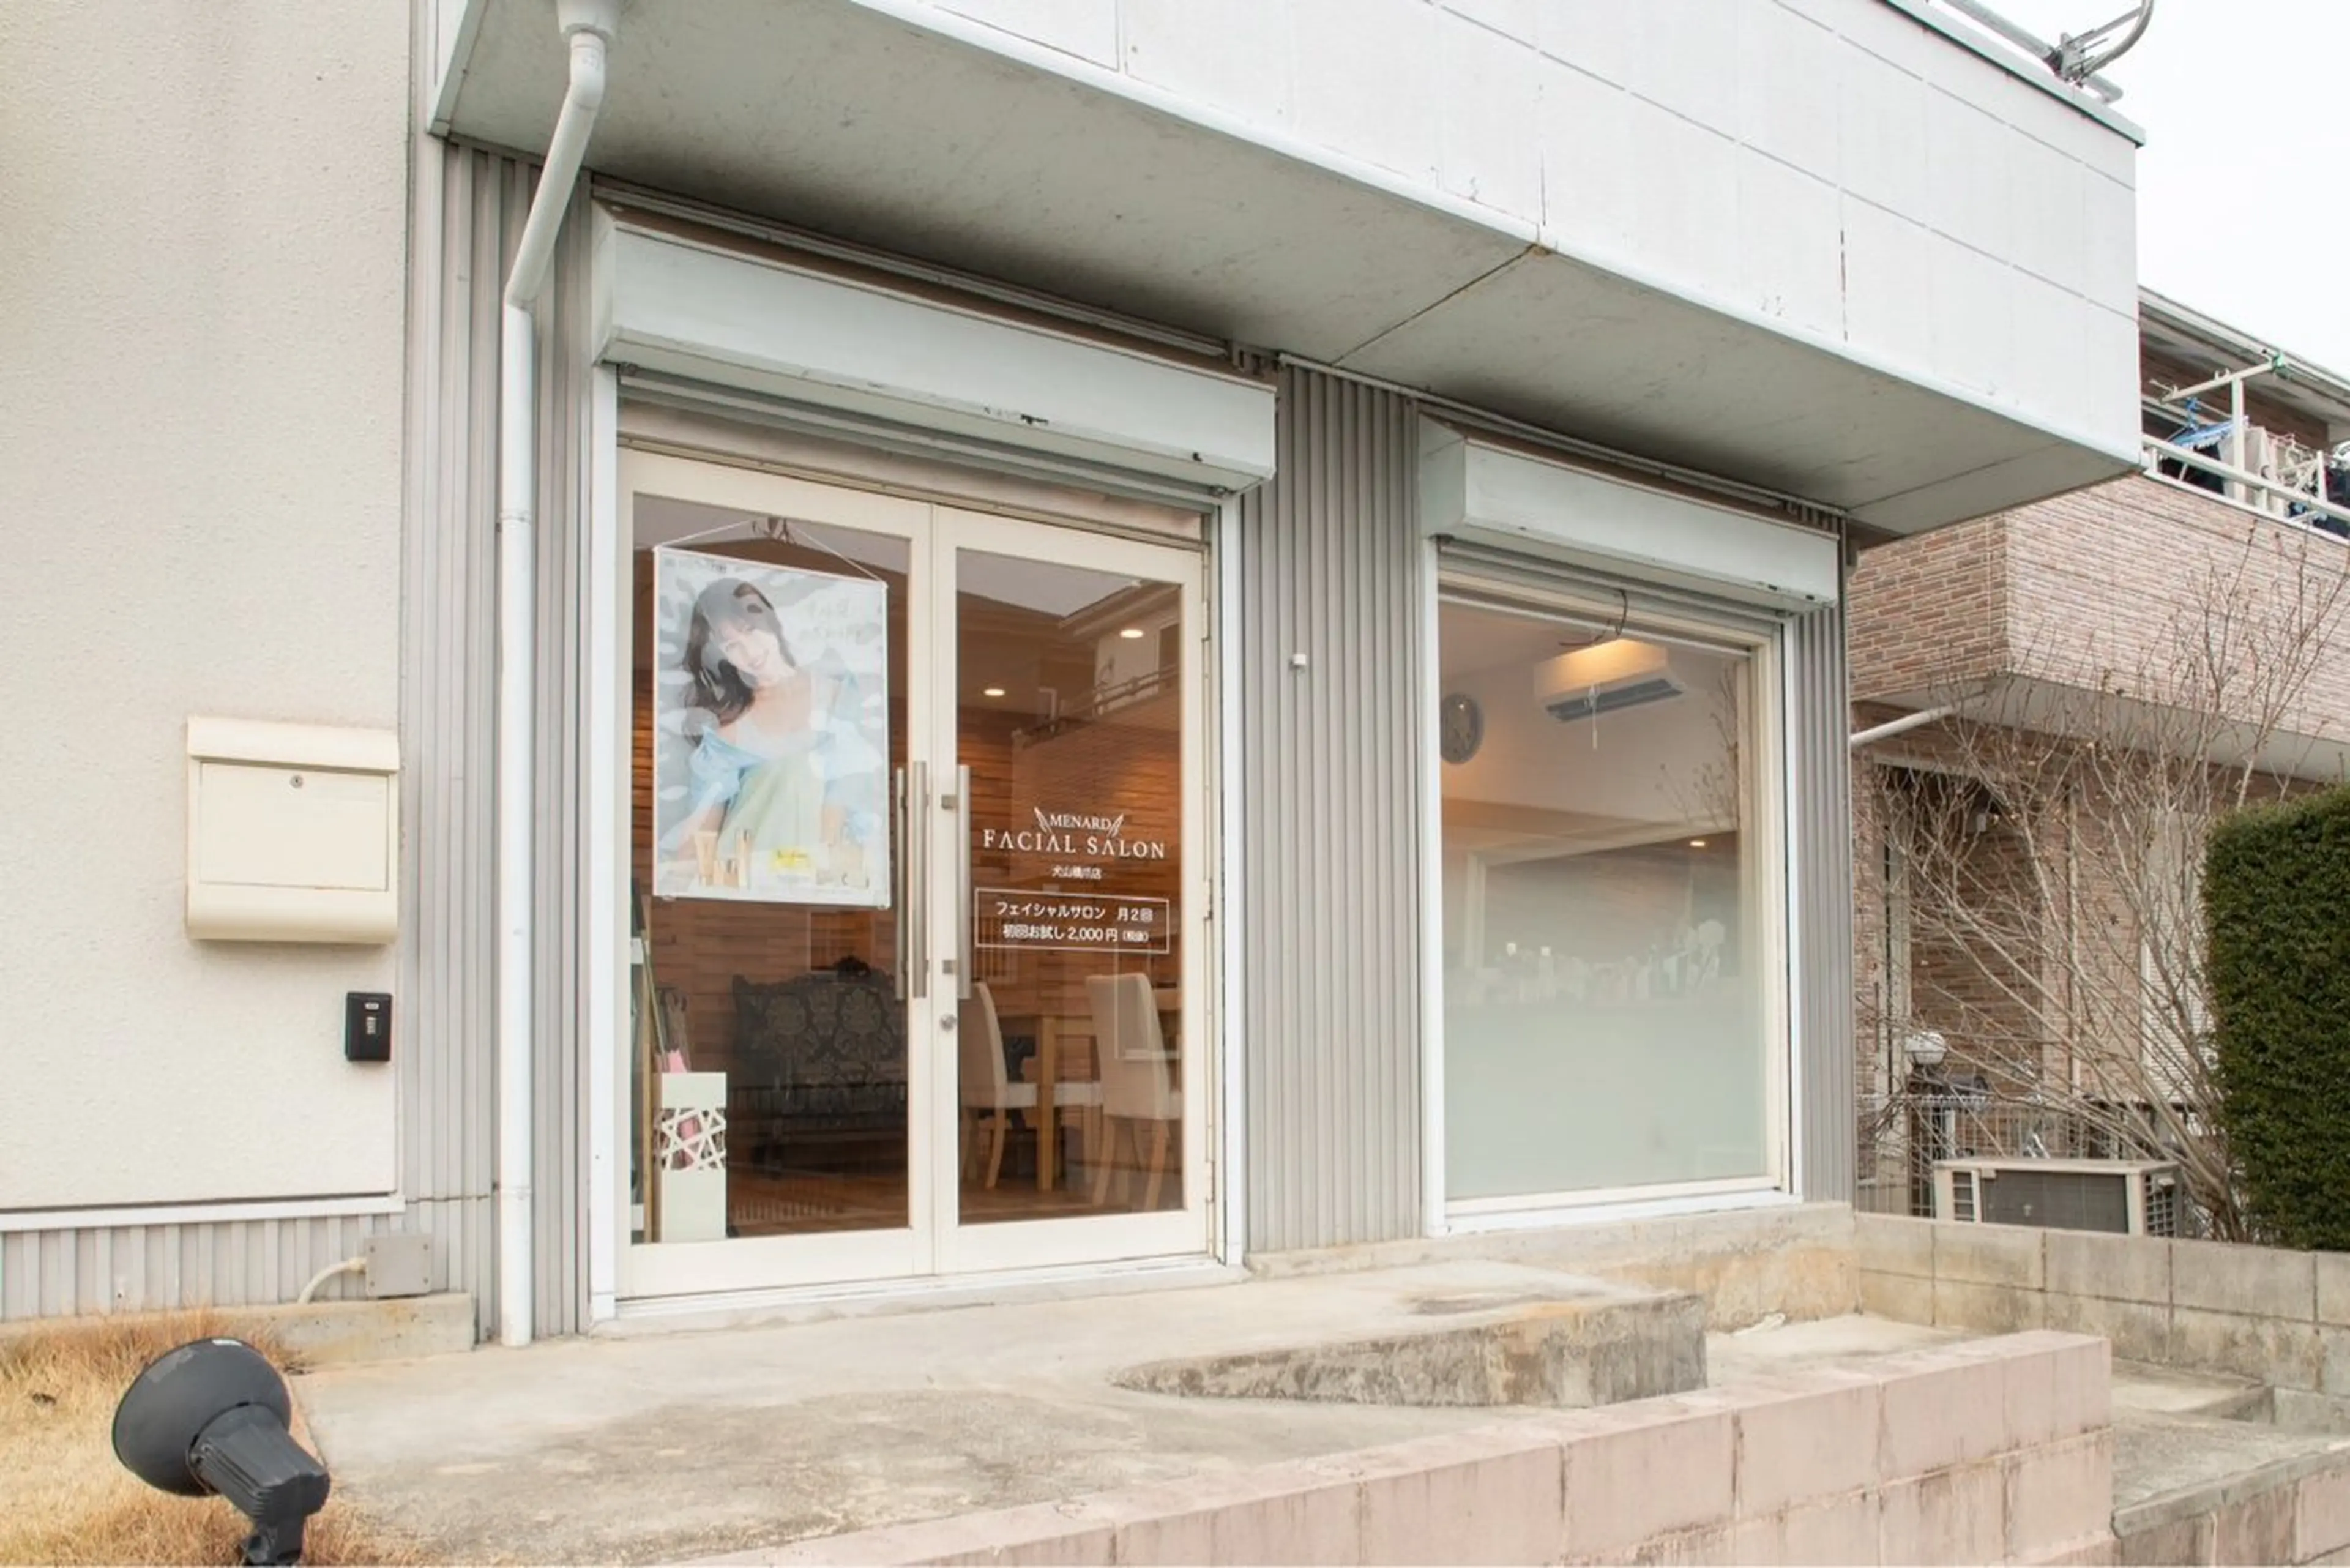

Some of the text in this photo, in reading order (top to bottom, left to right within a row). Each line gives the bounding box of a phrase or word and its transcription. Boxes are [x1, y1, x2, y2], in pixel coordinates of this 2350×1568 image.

[1050, 813, 1111, 830] MENARD
[983, 829, 1165, 858] FACIAL SALON
[996, 901, 1105, 919] フェイシャルサロン
